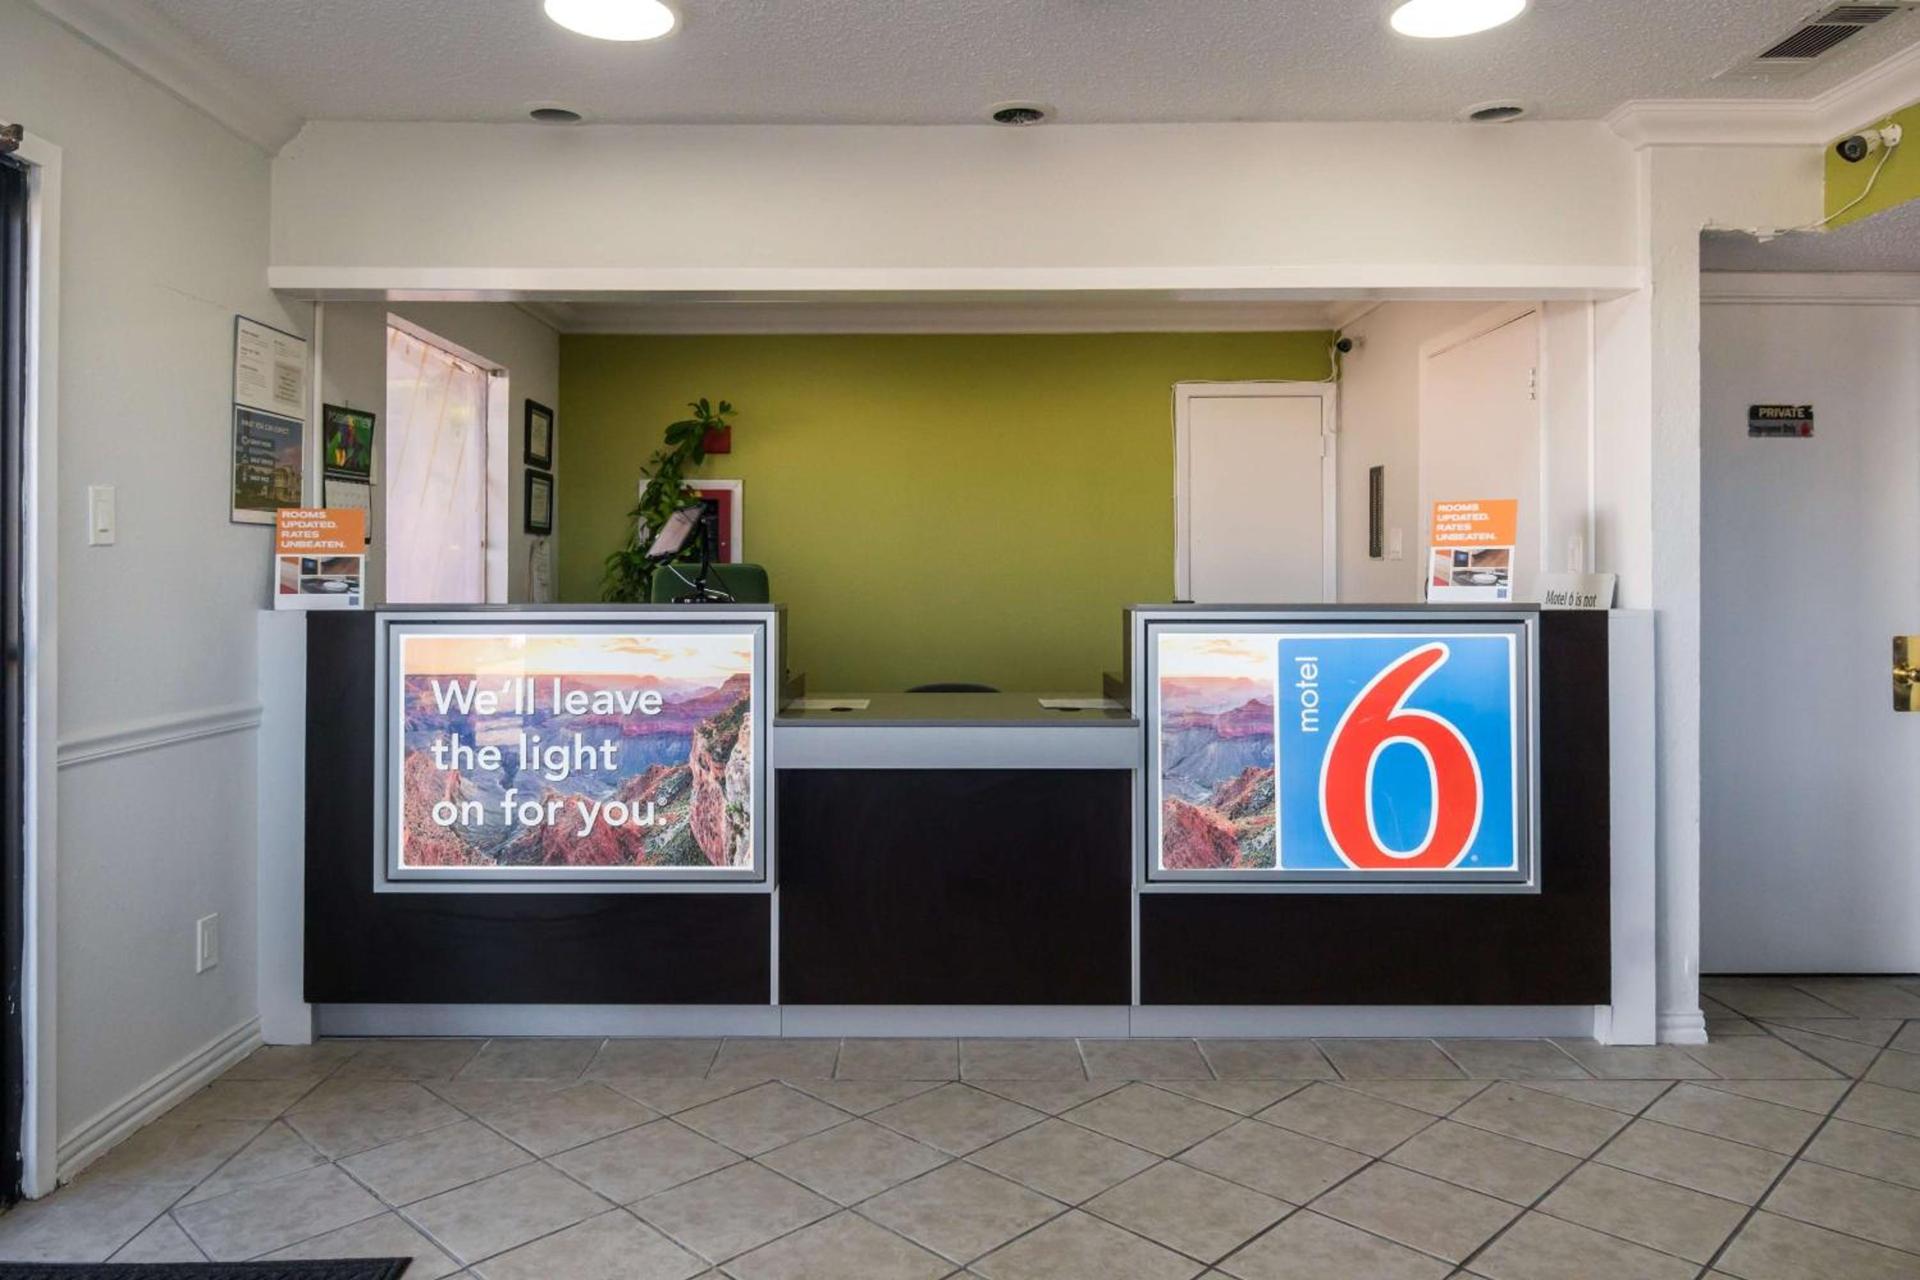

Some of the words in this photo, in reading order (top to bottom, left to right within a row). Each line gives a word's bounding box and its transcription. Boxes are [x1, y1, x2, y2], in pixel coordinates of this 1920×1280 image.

[1759, 407, 1805, 418] PRIVATE
[281, 511, 327, 519] ROOMS
[281, 520, 337, 529] UPDATED.
[1436, 523, 1472, 531] RATES
[281, 530, 320, 538] RATES
[281, 541, 346, 549] UNBEATEN.
[1545, 590, 1567, 606] Motel
[1568, 592, 1574, 606] 6
[1575, 593, 1582, 606] is
[1583, 594, 1597, 608] not
[431, 678, 535, 716] We'll
[553, 677, 663, 716] leave
[1295, 655, 1319, 733] motel
[431, 733, 501, 771] the
[519, 734, 618, 782] light
[1319, 641, 1484, 869] 6
[431, 800, 485, 827] on
[501, 788, 563, 826] for
[577, 800, 667, 837] you.
